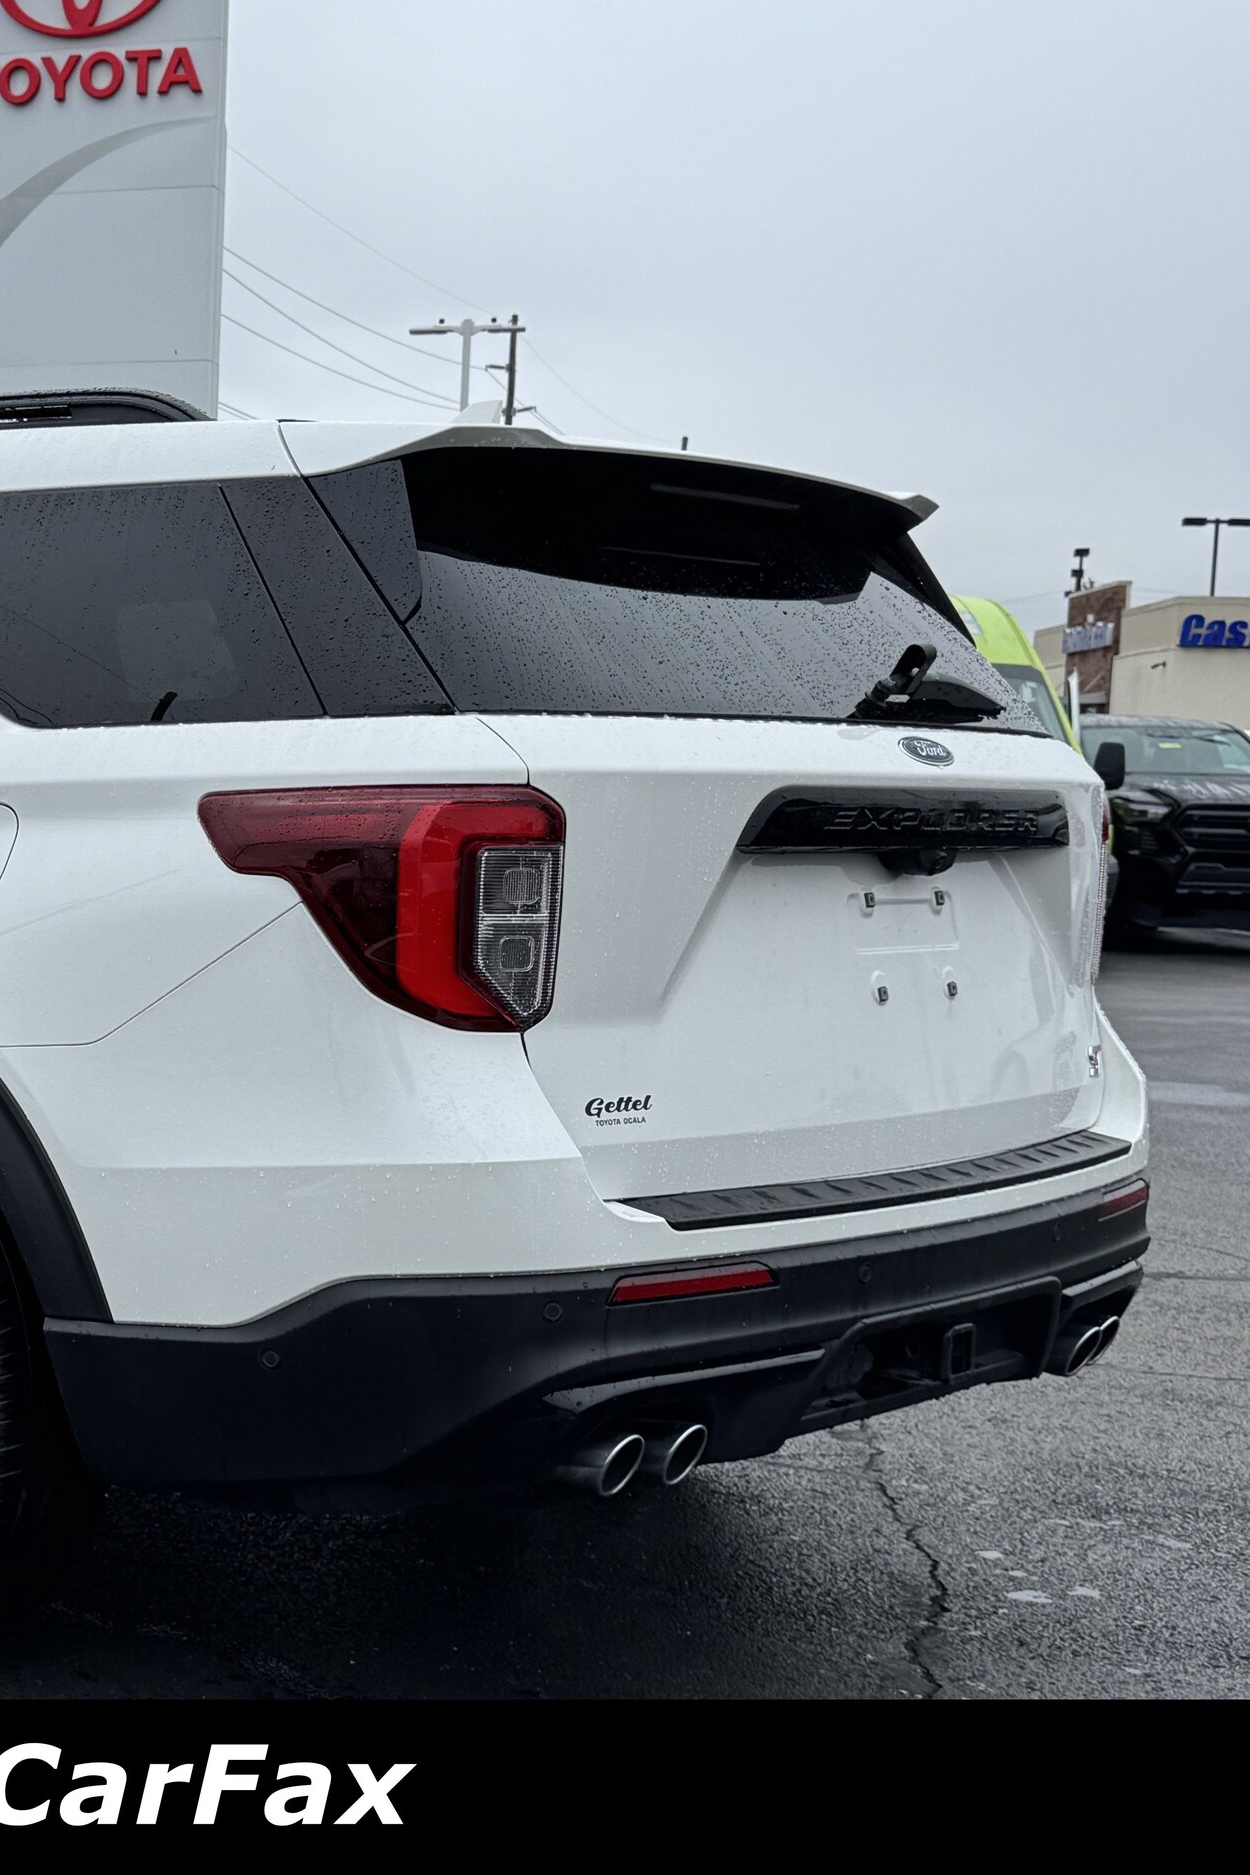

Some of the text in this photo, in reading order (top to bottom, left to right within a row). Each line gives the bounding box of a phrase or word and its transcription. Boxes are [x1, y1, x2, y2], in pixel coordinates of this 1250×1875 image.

[1178, 614, 1249, 648] Cas
[913, 738, 949, 758] Ford
[823, 806, 1038, 832] EXPLORER
[585, 1095, 652, 1118] Gettel
[595, 1116, 647, 1127] TOYOTA OCALA
